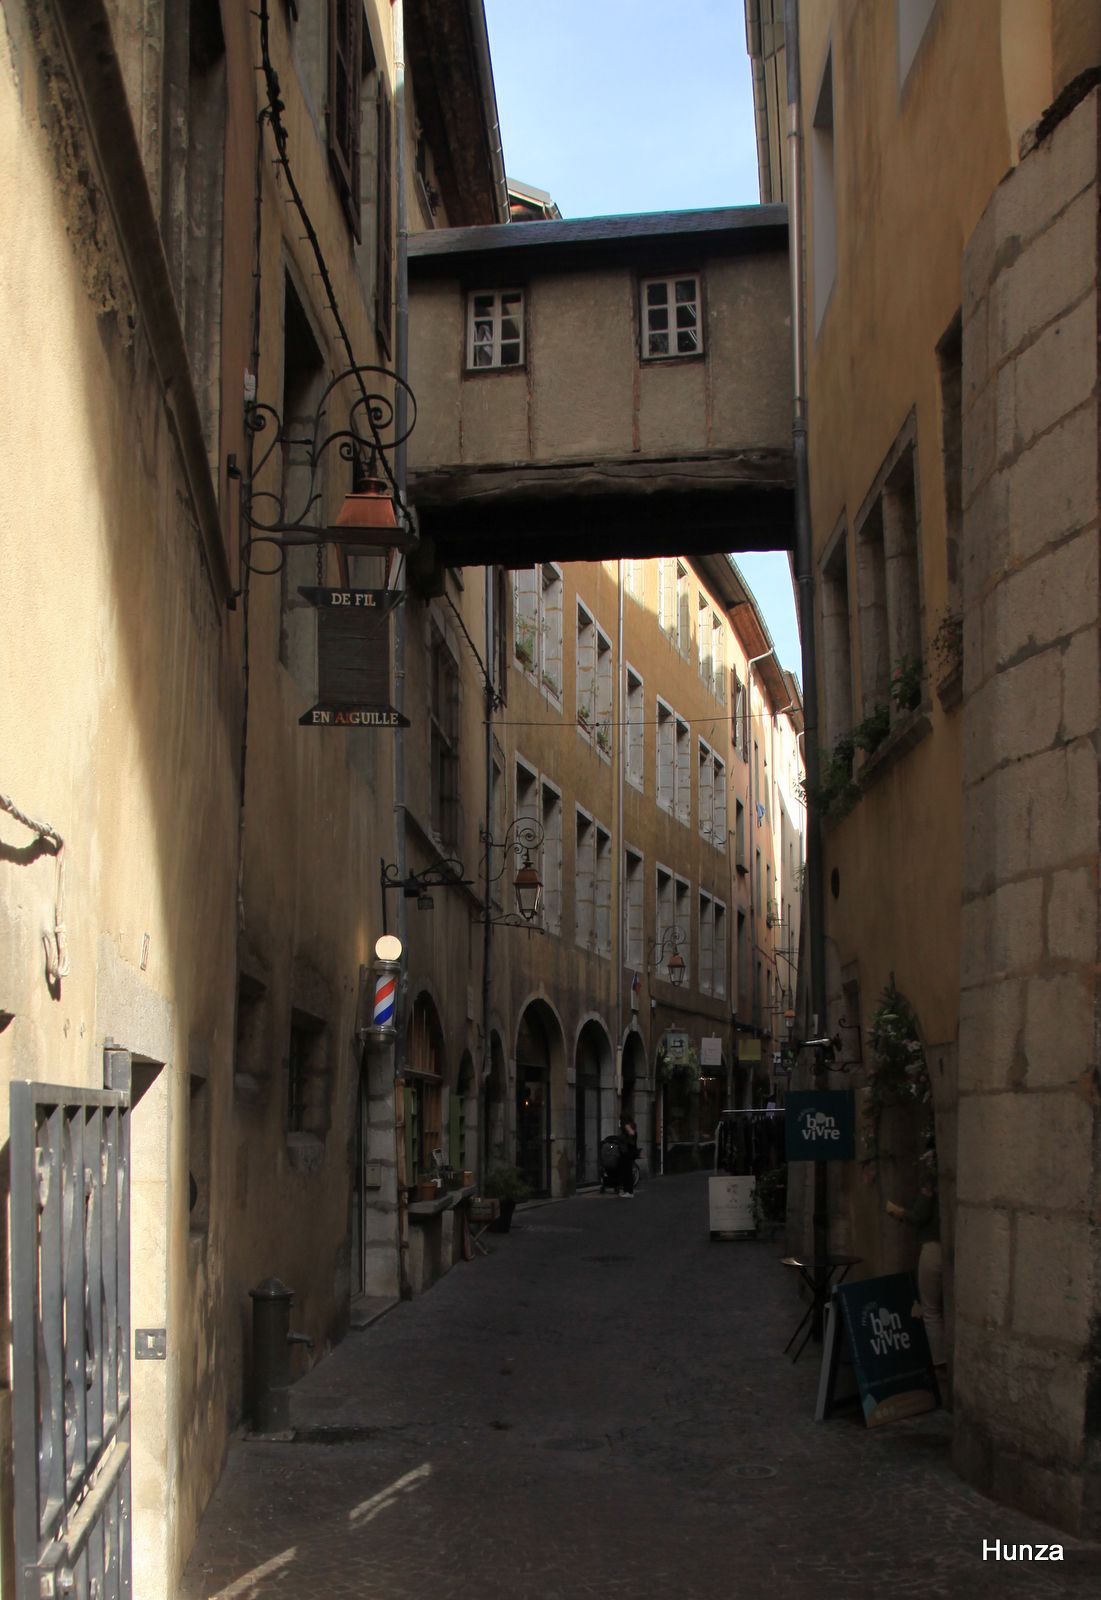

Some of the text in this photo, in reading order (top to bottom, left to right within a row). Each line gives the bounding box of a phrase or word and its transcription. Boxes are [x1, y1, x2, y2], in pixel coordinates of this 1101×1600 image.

[331, 592, 377, 607] DE FIL
[312, 710, 399, 725] EN AIGUILLE
[801, 1126, 840, 1141] vivre
[870, 1329, 911, 1356] vivre
